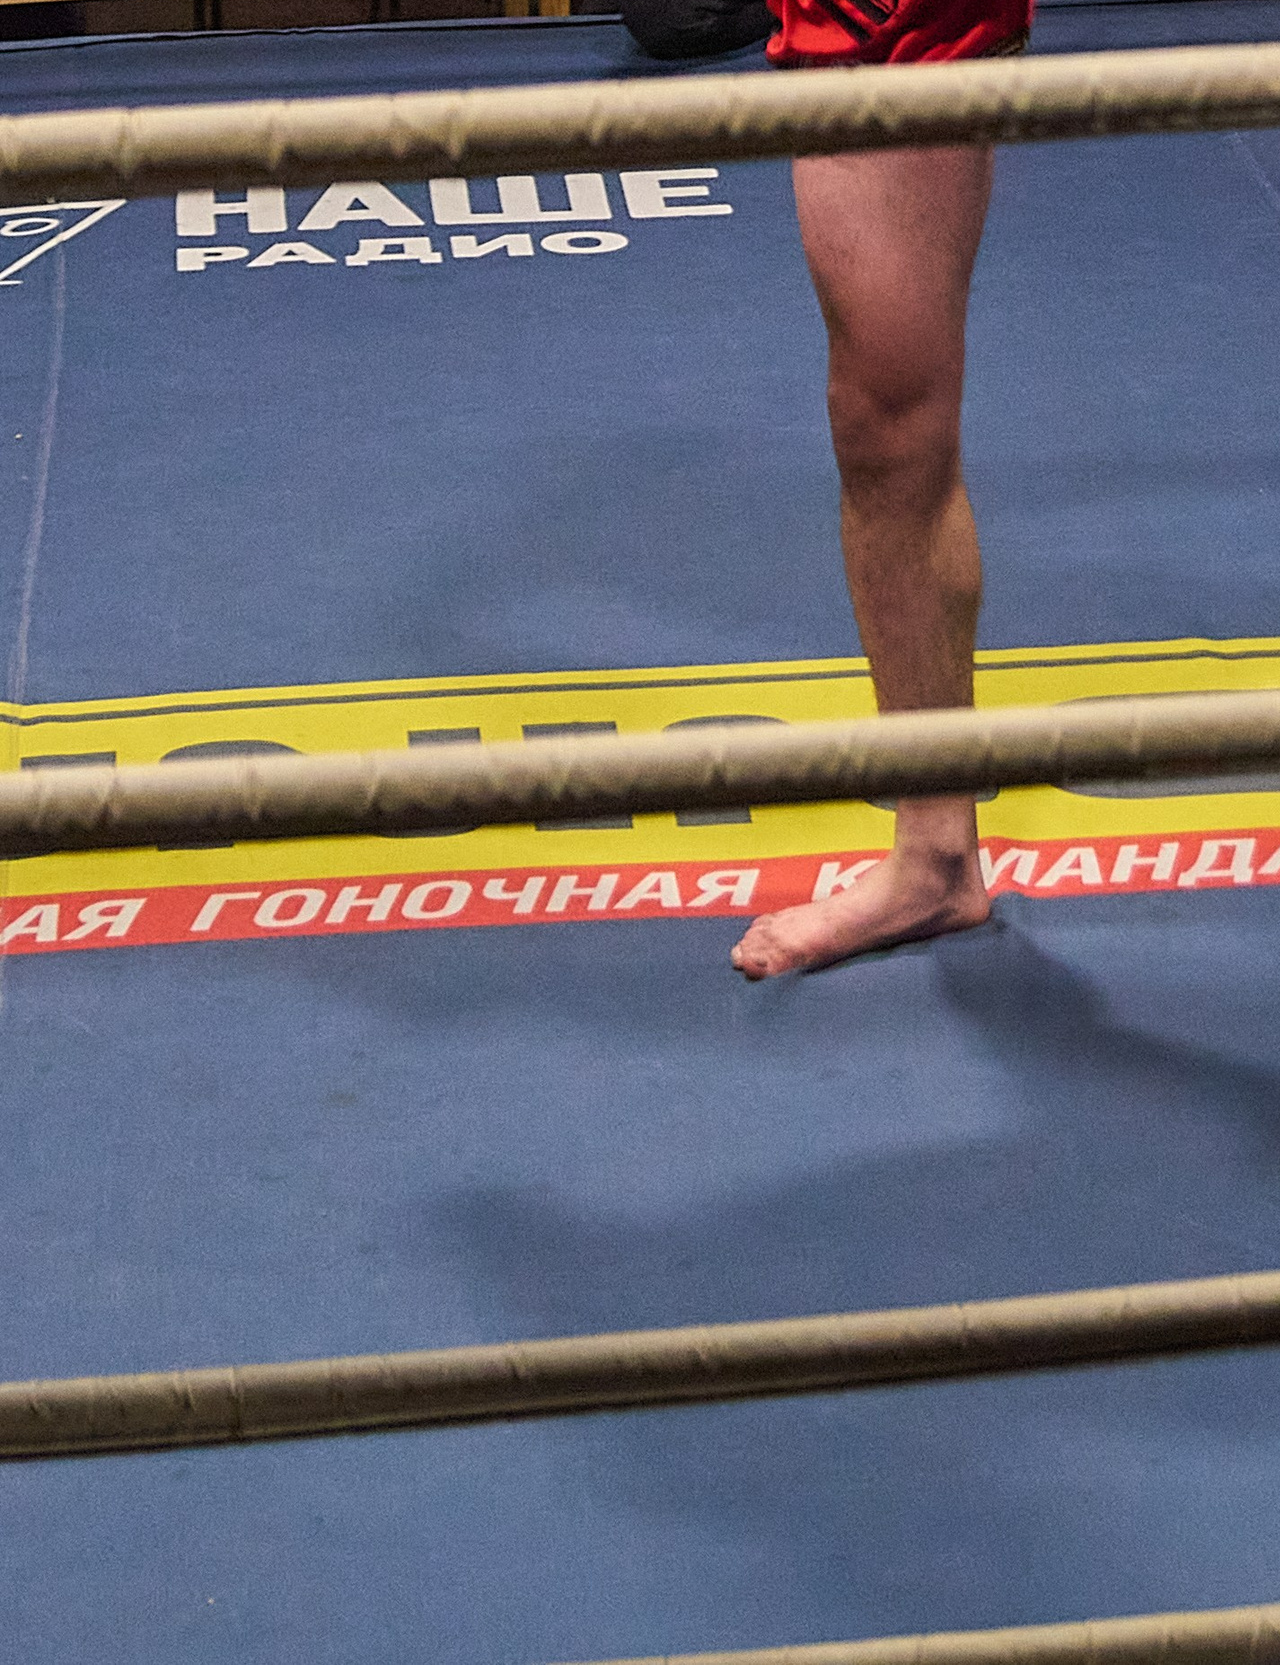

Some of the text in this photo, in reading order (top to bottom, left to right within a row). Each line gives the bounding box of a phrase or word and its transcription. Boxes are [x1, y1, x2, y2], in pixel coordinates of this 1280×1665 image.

[176, 168, 733, 237] НАШЕ
[176, 231, 629, 272] РАДИО
[190, 868, 761, 932] ГОНОЧНАЯ
